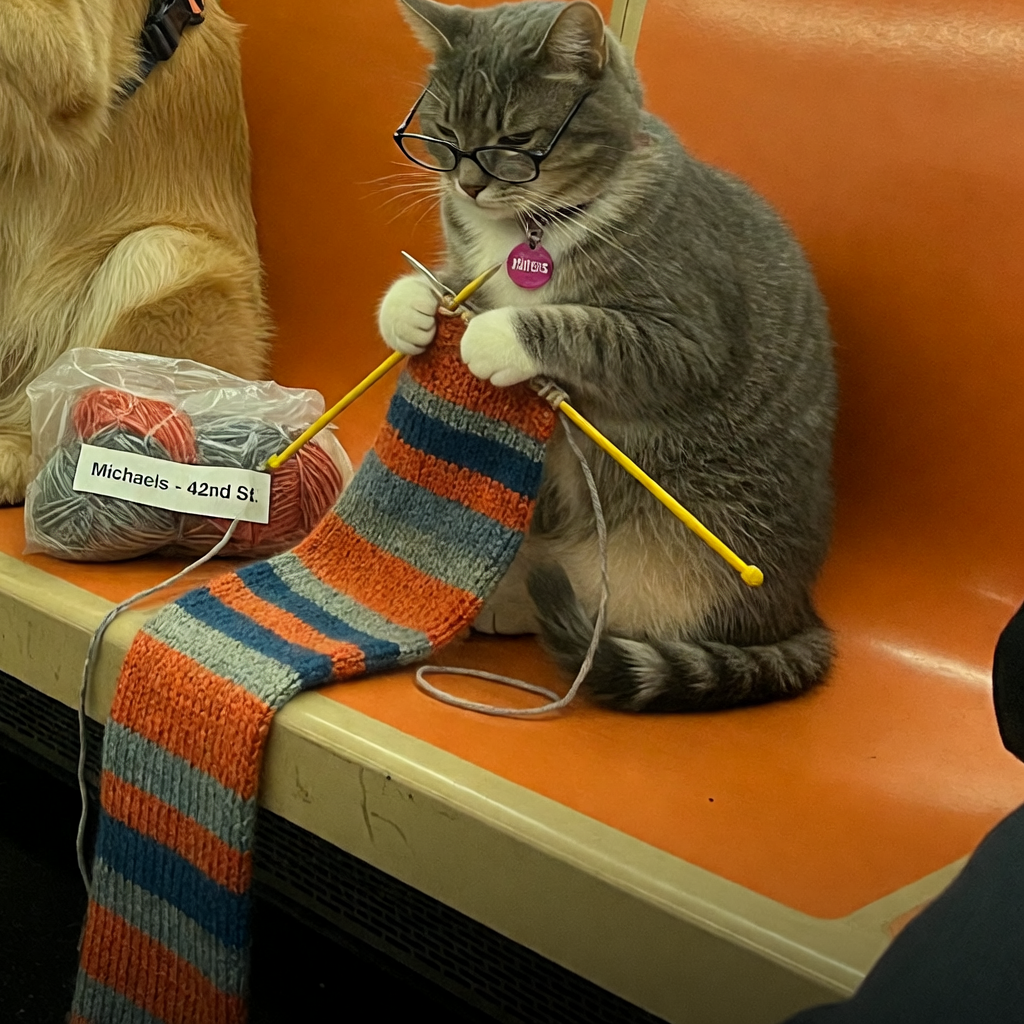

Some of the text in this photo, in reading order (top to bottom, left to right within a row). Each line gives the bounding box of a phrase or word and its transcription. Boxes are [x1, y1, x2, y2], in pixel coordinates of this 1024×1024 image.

[91, 462, 169, 491] Michaels
[187, 481, 231, 500] 42nd
[236, 486, 259, 503] St.
